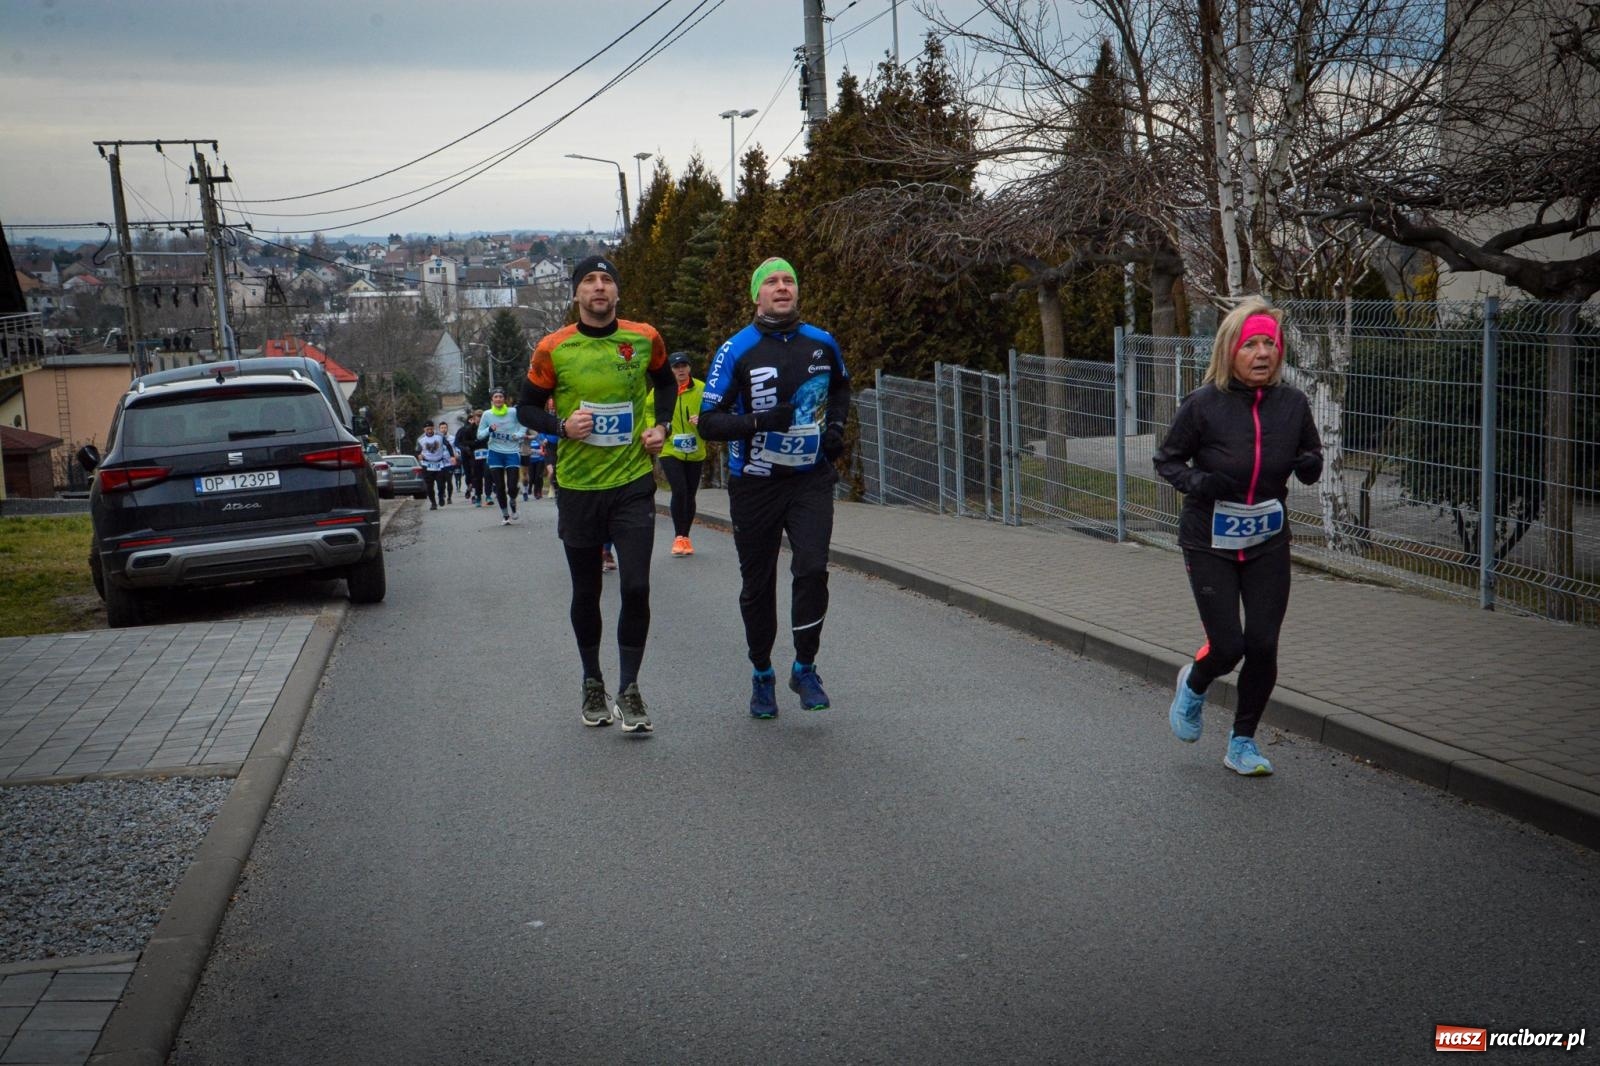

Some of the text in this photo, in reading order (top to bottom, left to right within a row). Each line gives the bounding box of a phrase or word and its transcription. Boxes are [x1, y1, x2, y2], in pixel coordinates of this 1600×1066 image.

[594, 415, 620, 434] 82
[779, 437, 806, 454] 52
[205, 472, 276, 491] OP 1239P
[1224, 515, 1272, 536] 231
